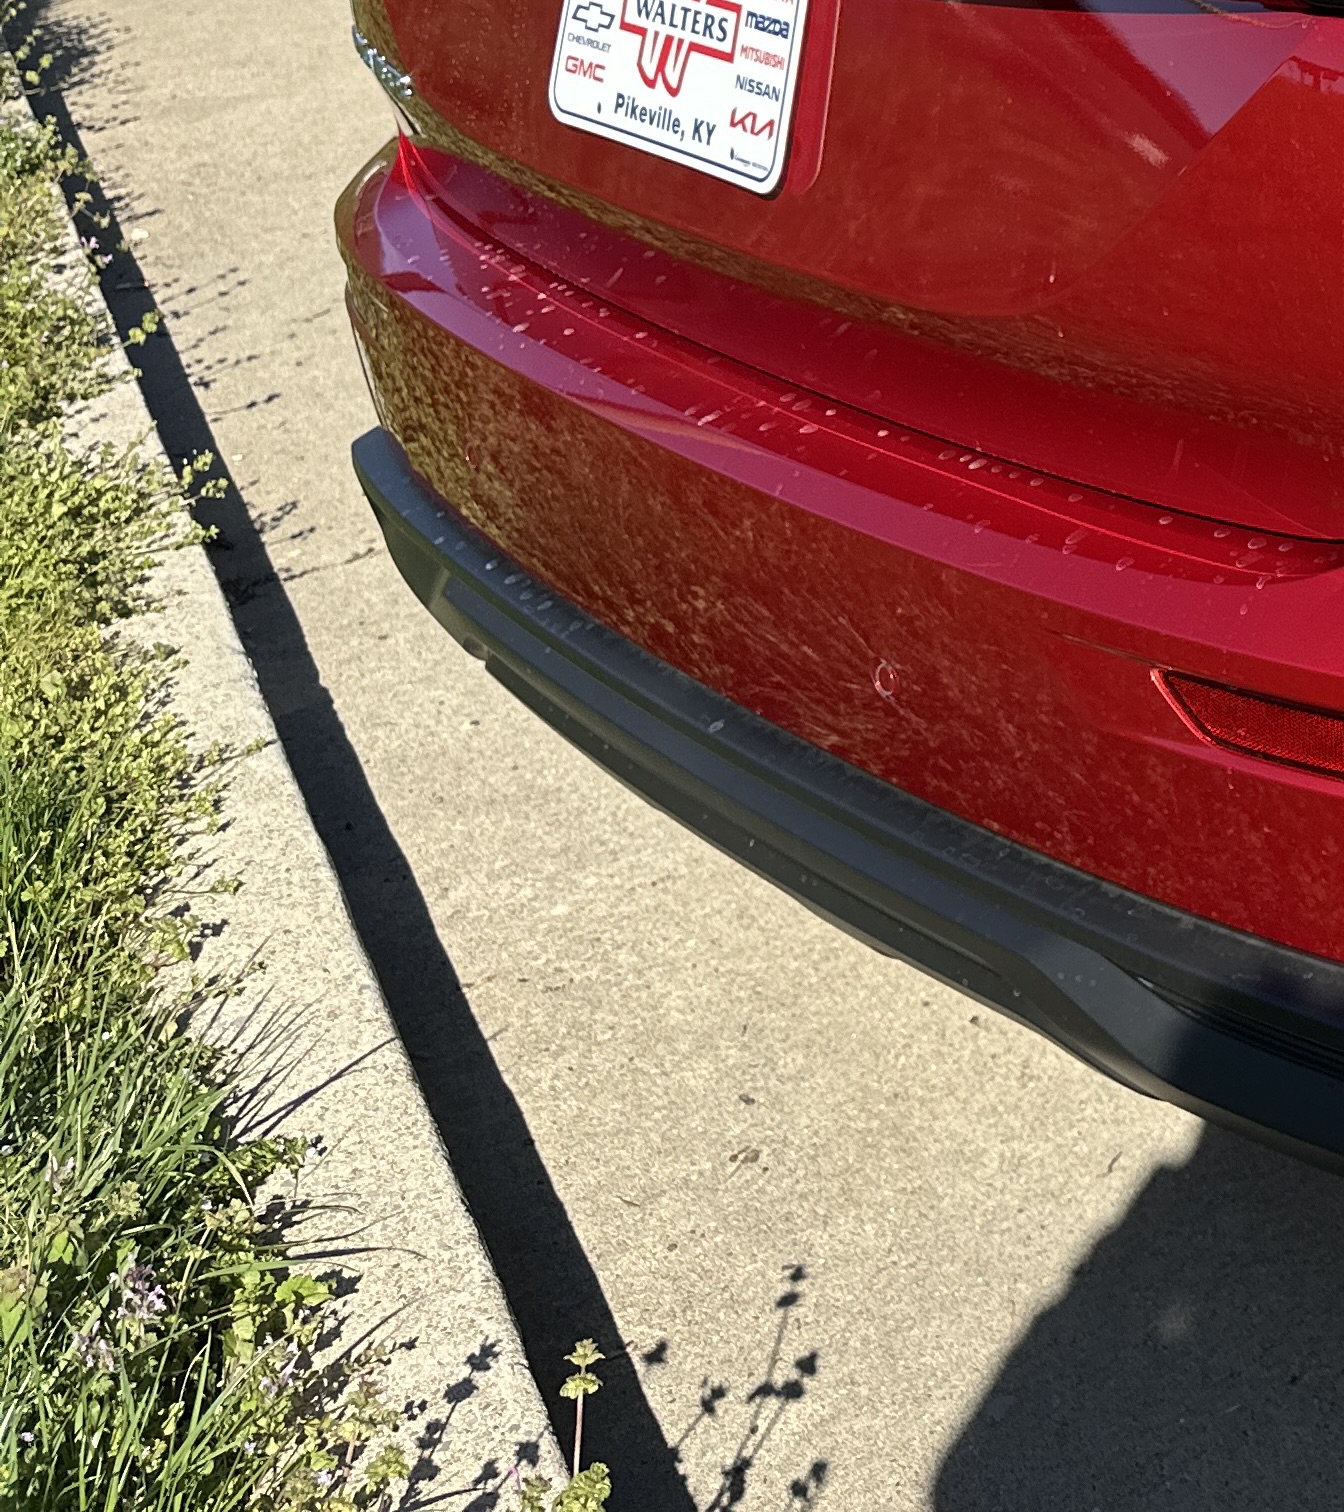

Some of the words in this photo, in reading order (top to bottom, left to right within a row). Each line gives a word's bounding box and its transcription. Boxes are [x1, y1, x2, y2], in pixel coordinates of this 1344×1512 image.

[567, 32, 612, 54] CHEVROLET
[565, 55, 606, 83] GMC
[739, 44, 785, 71] MITSUBISHI
[735, 74, 781, 103] NISSAN
[614, 92, 685, 142] Pikeville,
[692, 120, 717, 146] KY
